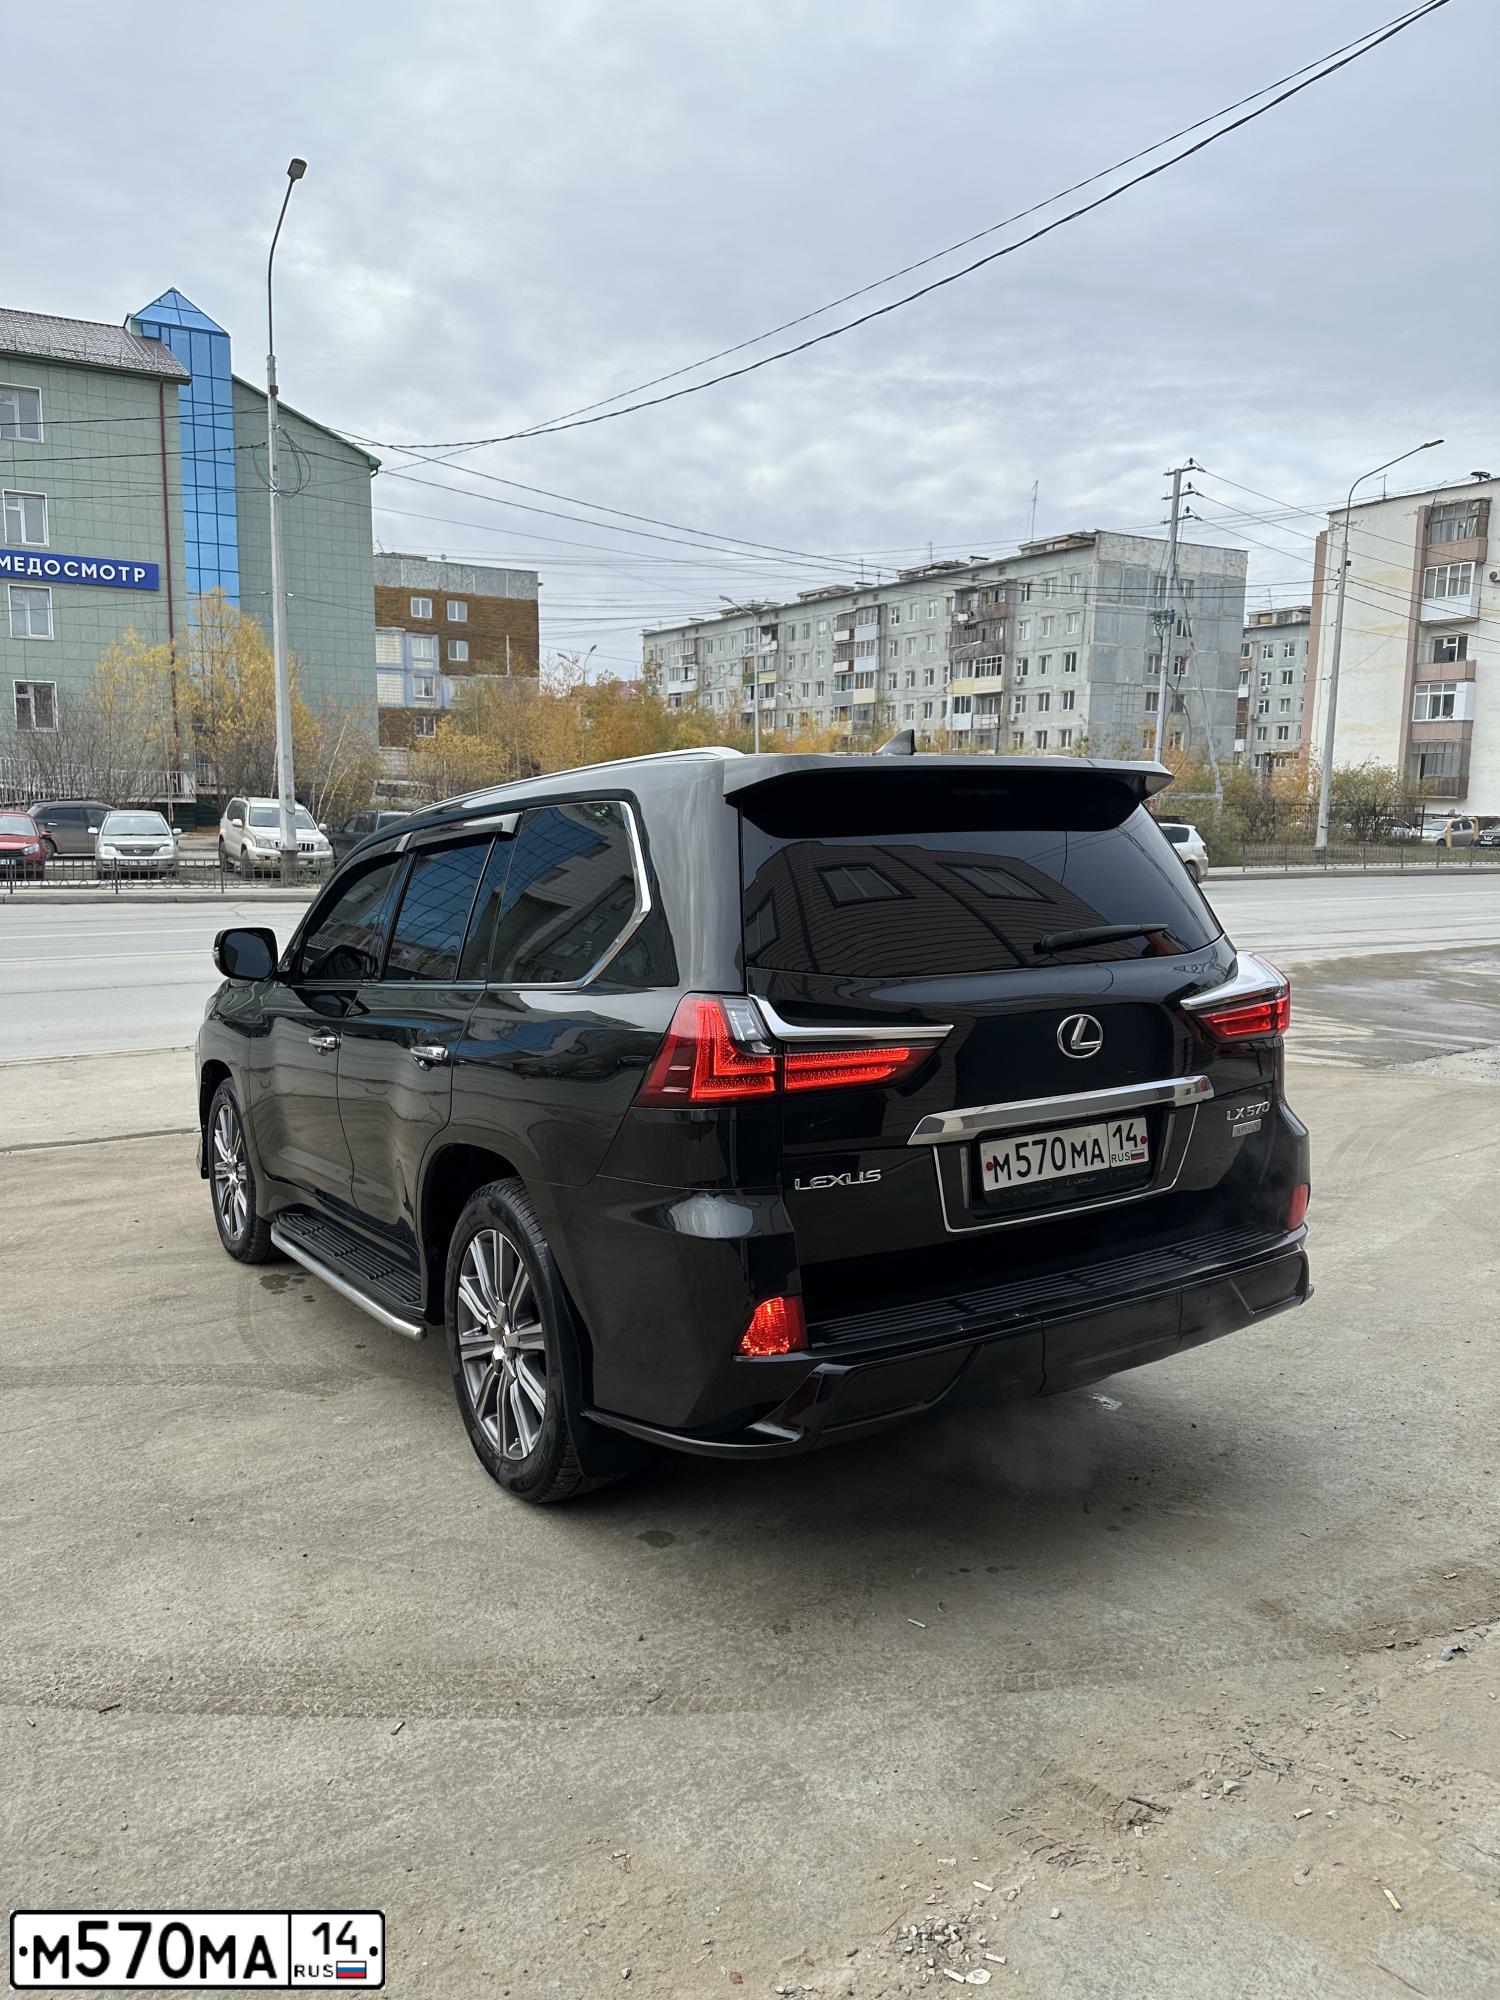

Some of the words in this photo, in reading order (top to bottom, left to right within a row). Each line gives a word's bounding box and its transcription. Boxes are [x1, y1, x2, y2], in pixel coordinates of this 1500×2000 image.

[0, 555, 146, 583] МЕДОСМОТР
[1226, 1107, 1245, 1121] LX
[1246, 1101, 1270, 1117] 570
[1112, 1122, 1138, 1150] 14
[1111, 1151, 1131, 1163] RUS
[794, 1169, 882, 1190] LEXUS
